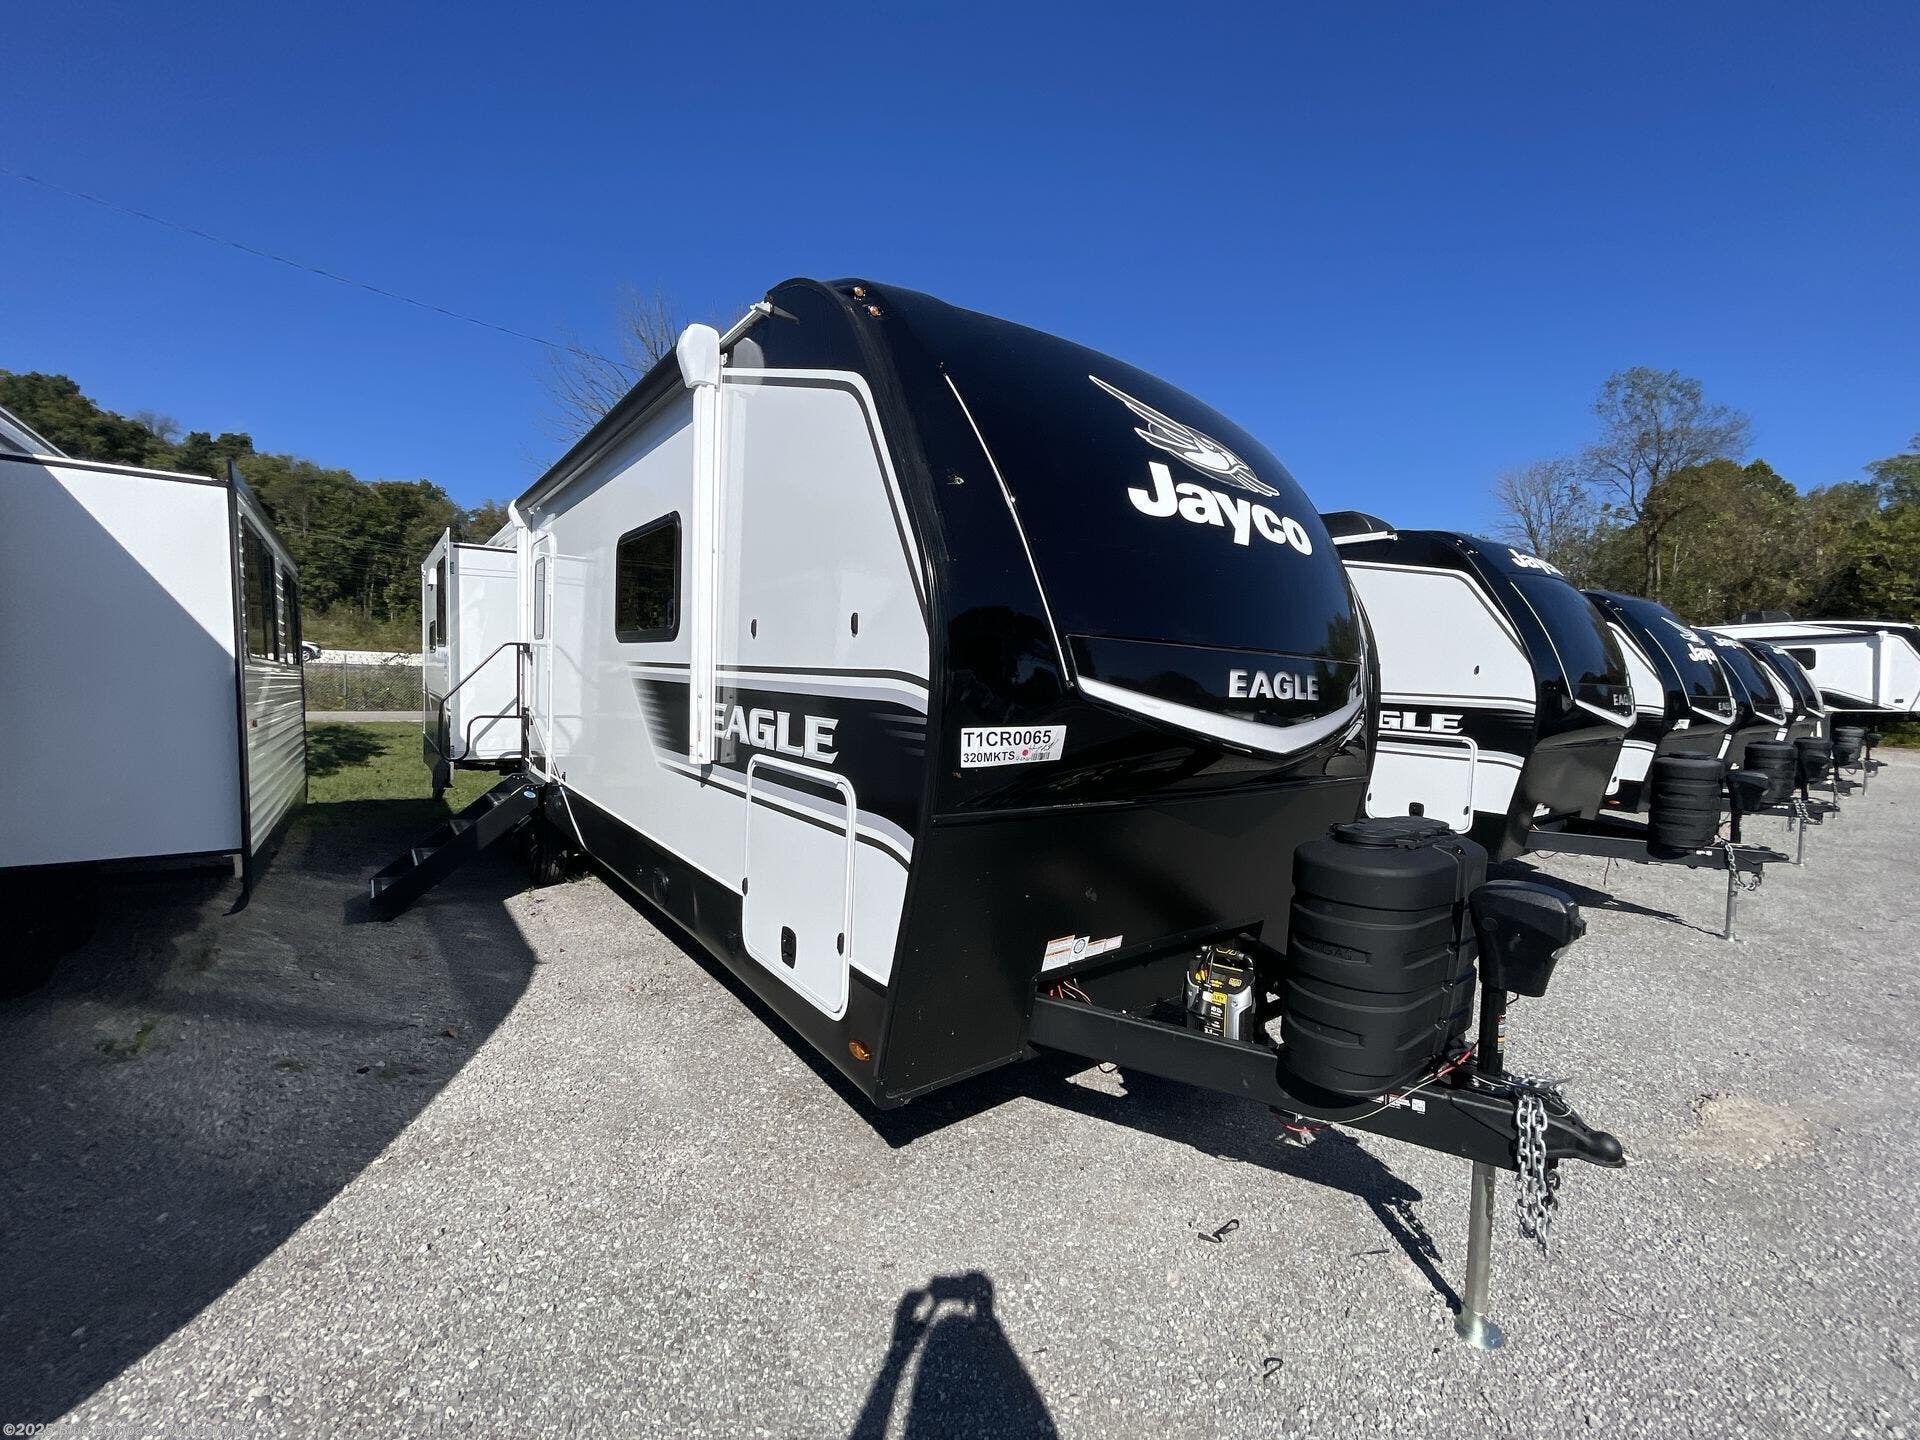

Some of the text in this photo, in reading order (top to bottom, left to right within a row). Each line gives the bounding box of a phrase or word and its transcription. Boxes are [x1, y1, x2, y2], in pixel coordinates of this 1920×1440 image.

[1128, 461, 1312, 555] Jayco
[1228, 668, 1320, 700] EAGLE
[1379, 710, 1464, 734] GLE
[963, 730, 1052, 747] T1CR0065
[963, 751, 1015, 763] 320MKTS
